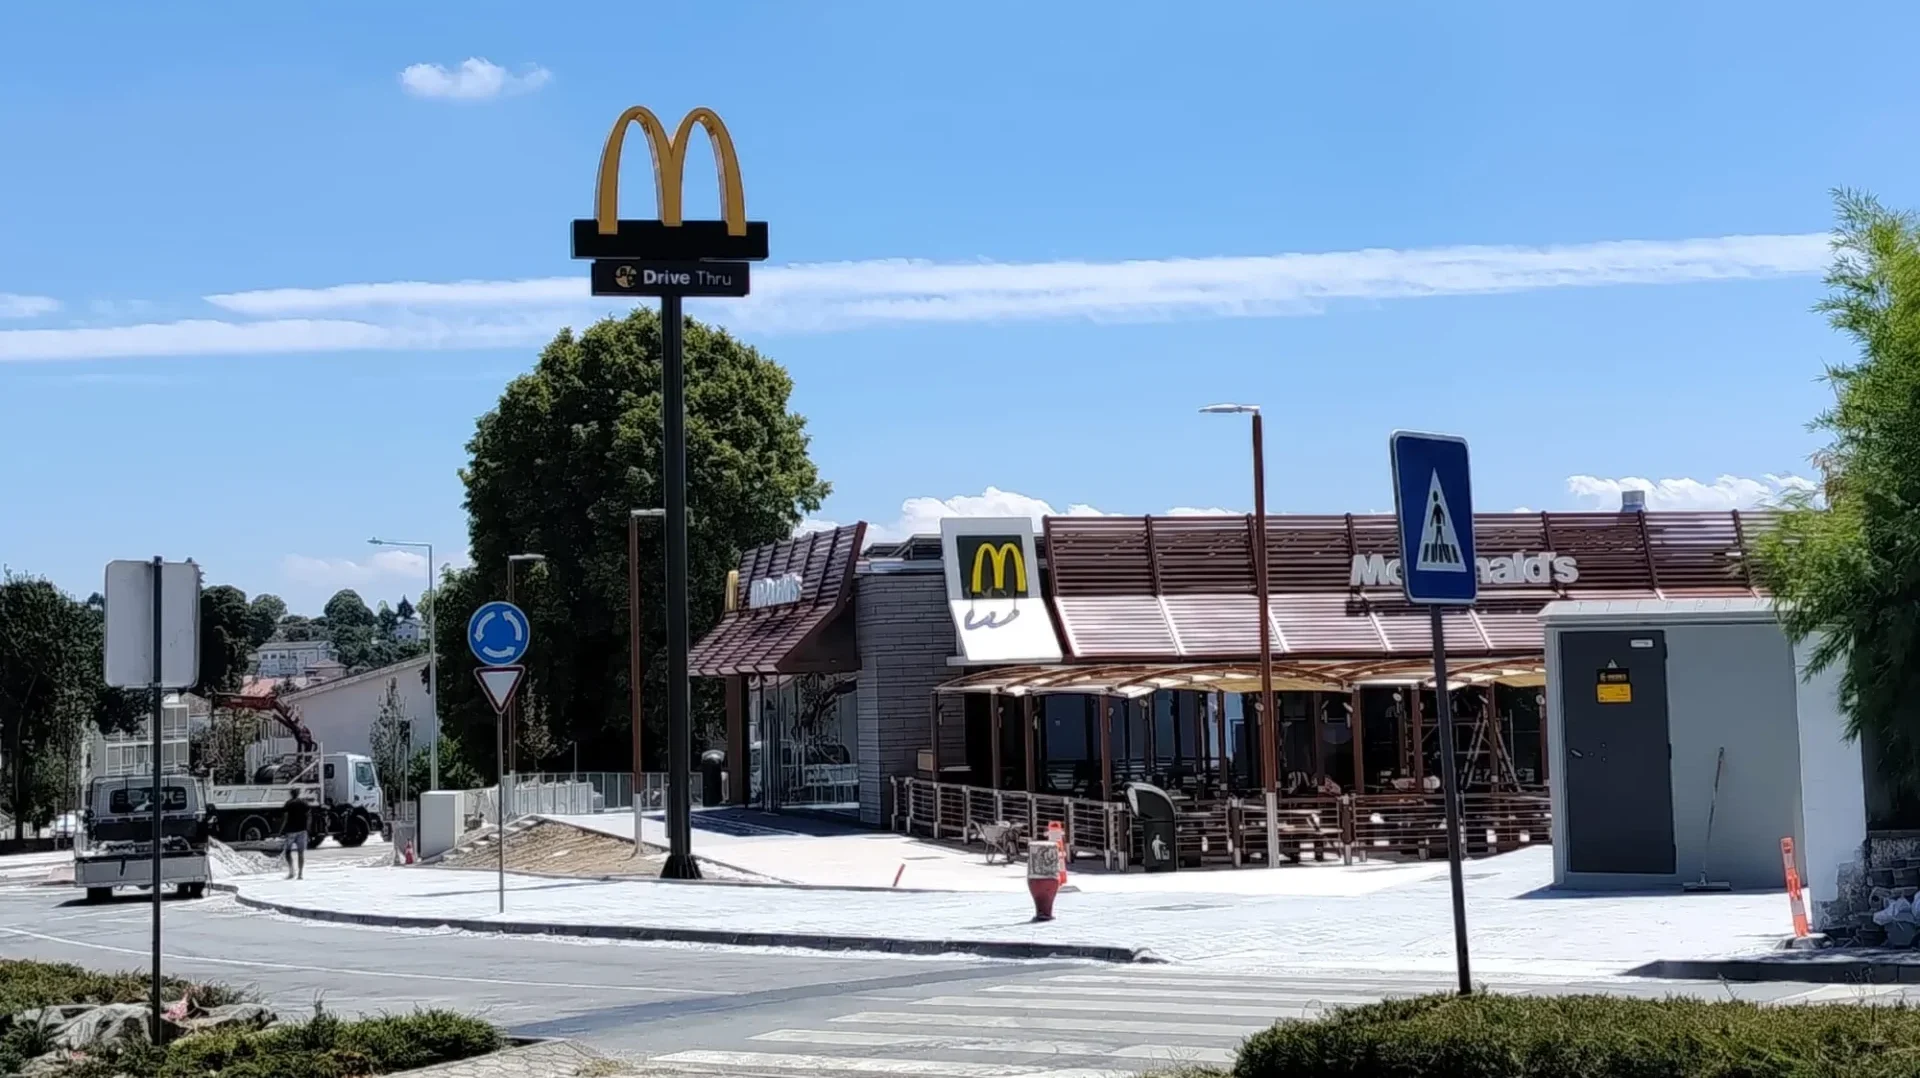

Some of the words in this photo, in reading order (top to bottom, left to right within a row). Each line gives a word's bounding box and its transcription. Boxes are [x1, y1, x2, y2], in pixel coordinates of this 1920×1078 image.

[643, 269, 691, 285] Drive
[695, 270, 732, 286] Thru
[1350, 552, 1579, 586] Mcnald's
